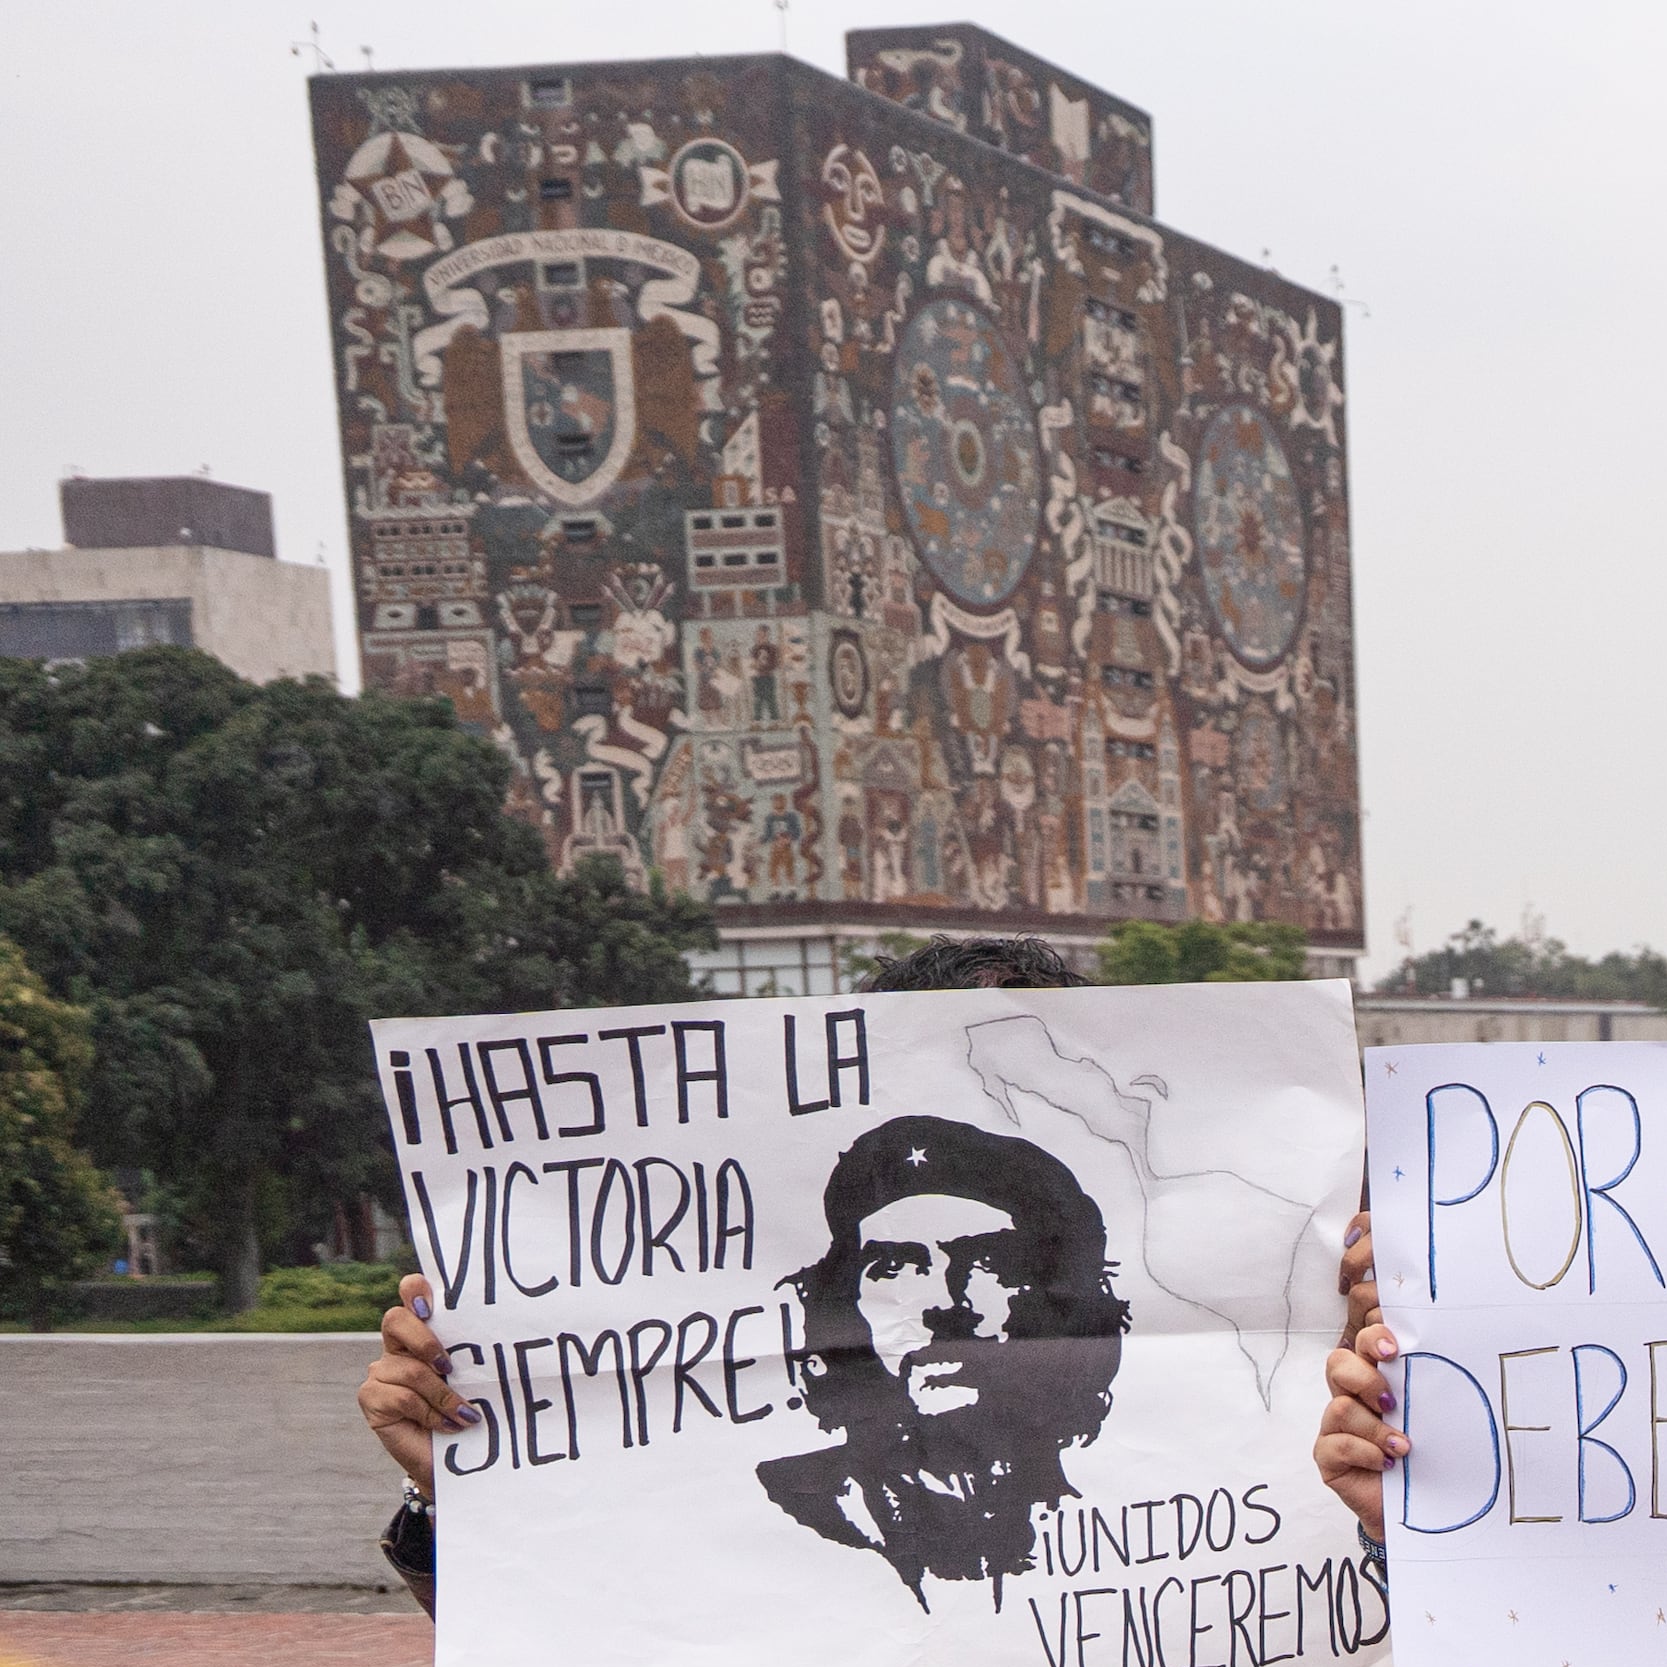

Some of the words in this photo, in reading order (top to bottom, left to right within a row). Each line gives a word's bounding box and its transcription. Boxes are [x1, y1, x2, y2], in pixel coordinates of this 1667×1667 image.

[390, 1020, 729, 1154] ¡HASTA
[783, 1007, 870, 1117] LA
[411, 1157, 753, 1311] VICTORIA
[1425, 1082, 1667, 1303] POR
[444, 1302, 804, 1477] SIEMPRE!
[1034, 1484, 1281, 1578] ¡UNIDOS
